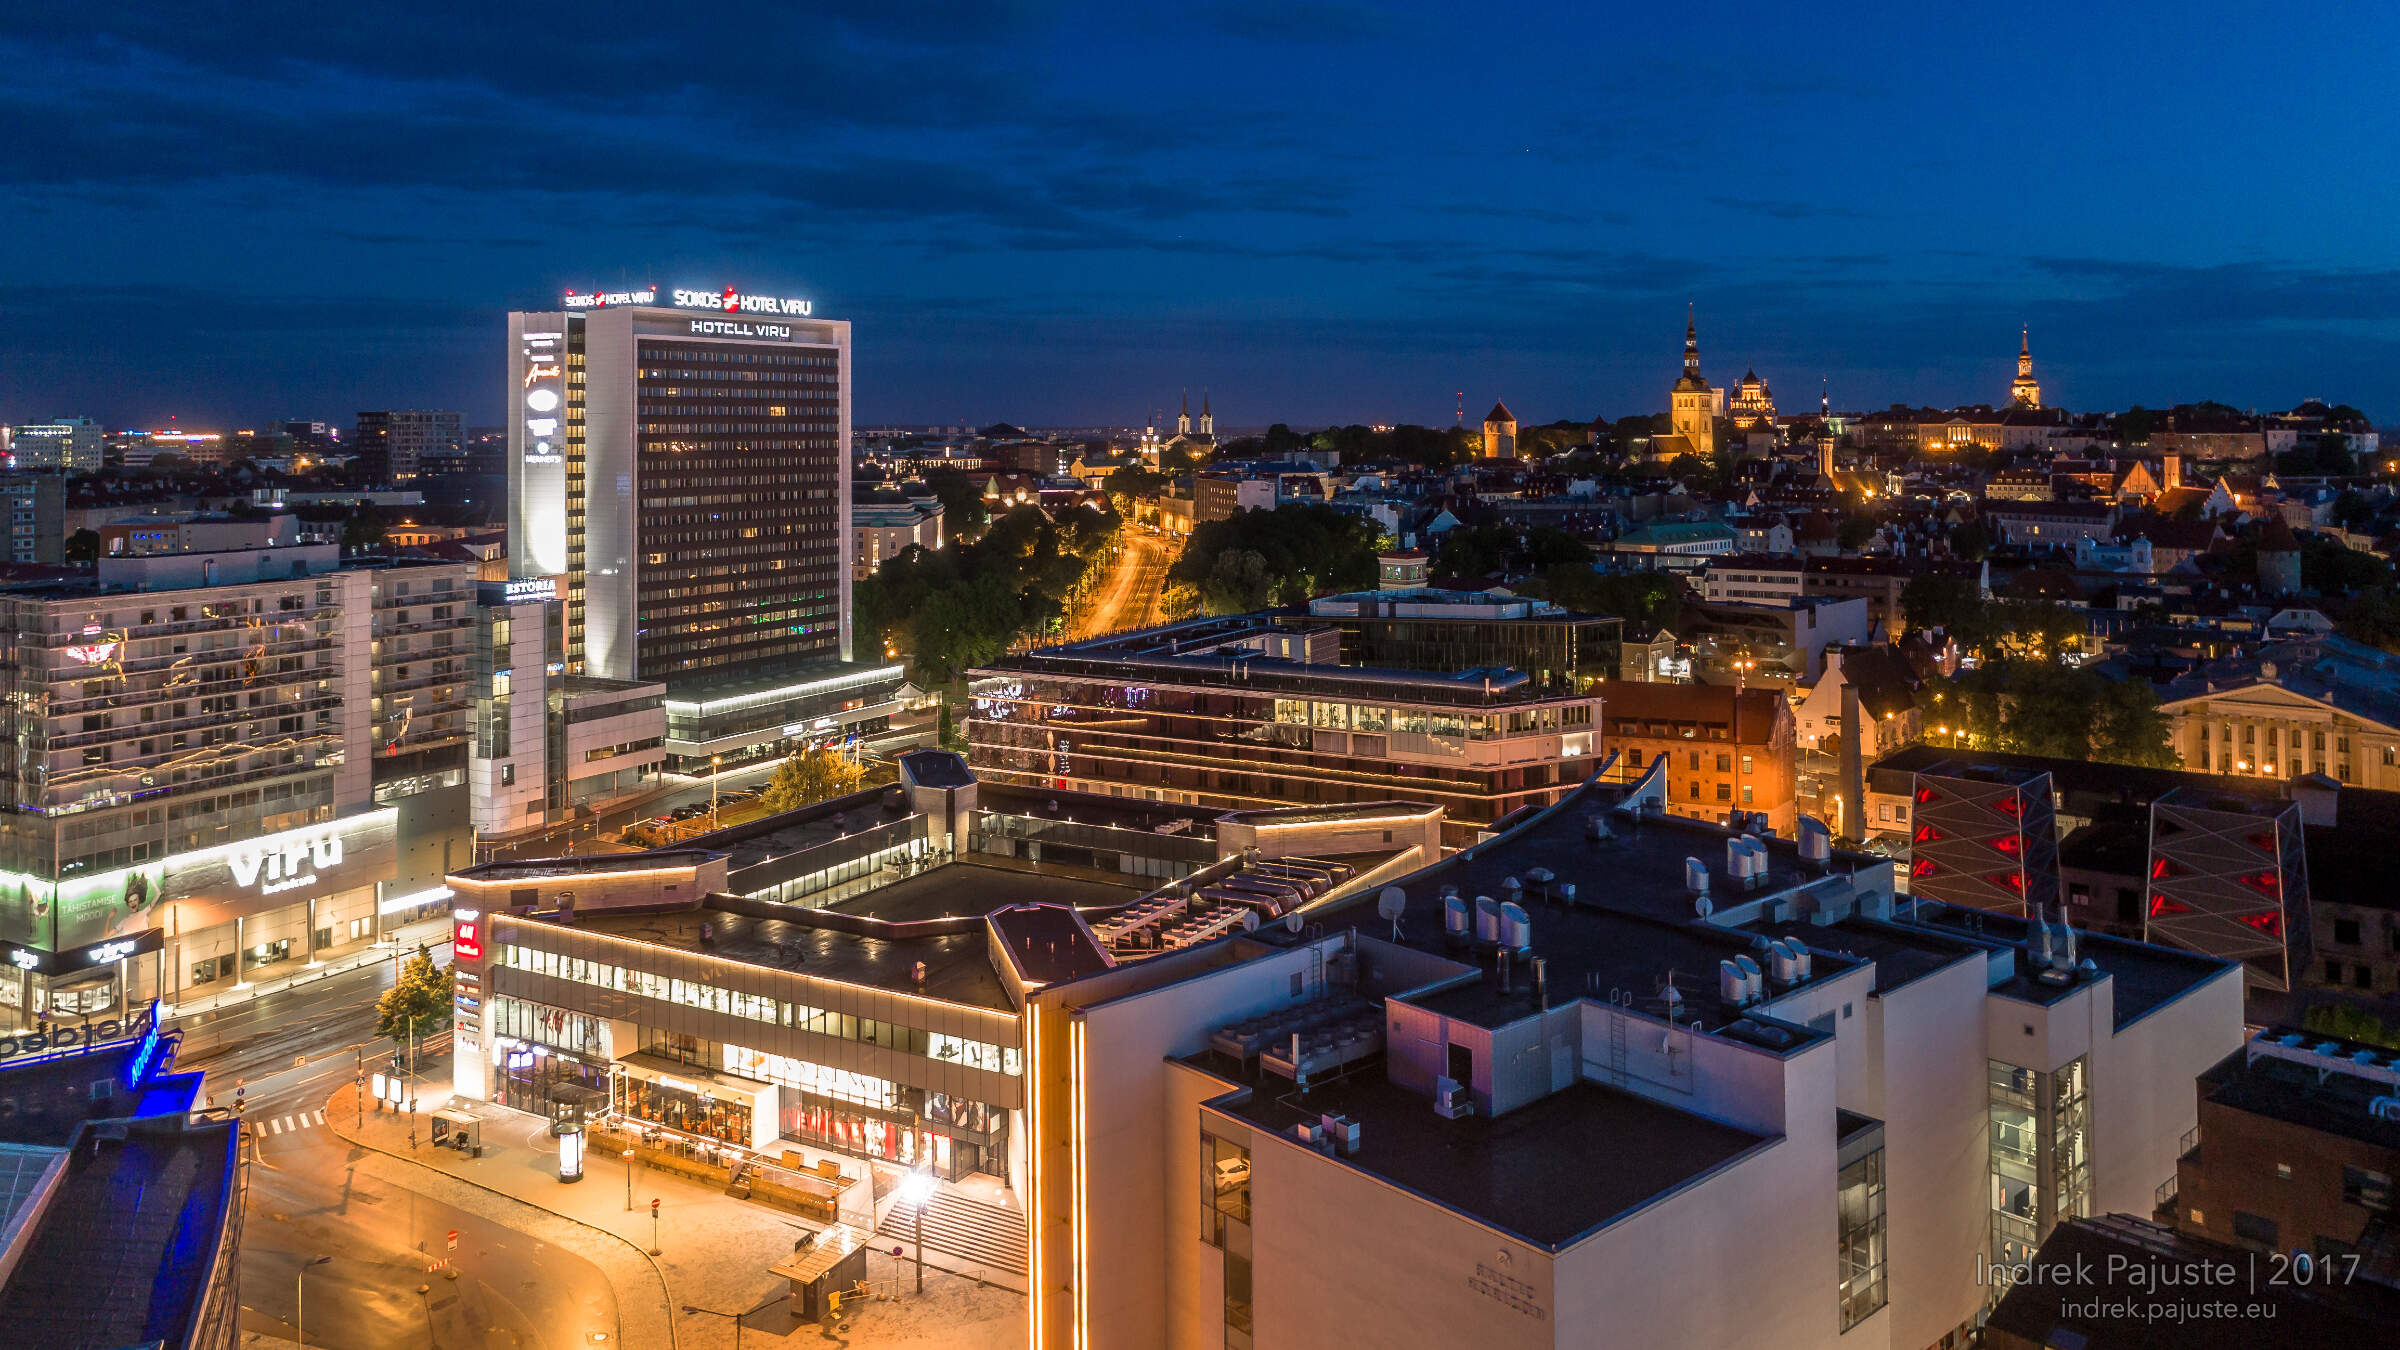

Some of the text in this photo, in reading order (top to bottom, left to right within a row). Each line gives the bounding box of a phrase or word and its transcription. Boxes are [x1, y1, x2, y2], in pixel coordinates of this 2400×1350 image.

[606, 292, 631, 305] HOTEL
[631, 291, 654, 304] VIRU
[673, 289, 812, 316] SOKOS HOTEL VIRU
[756, 324, 790, 338] VIRU
